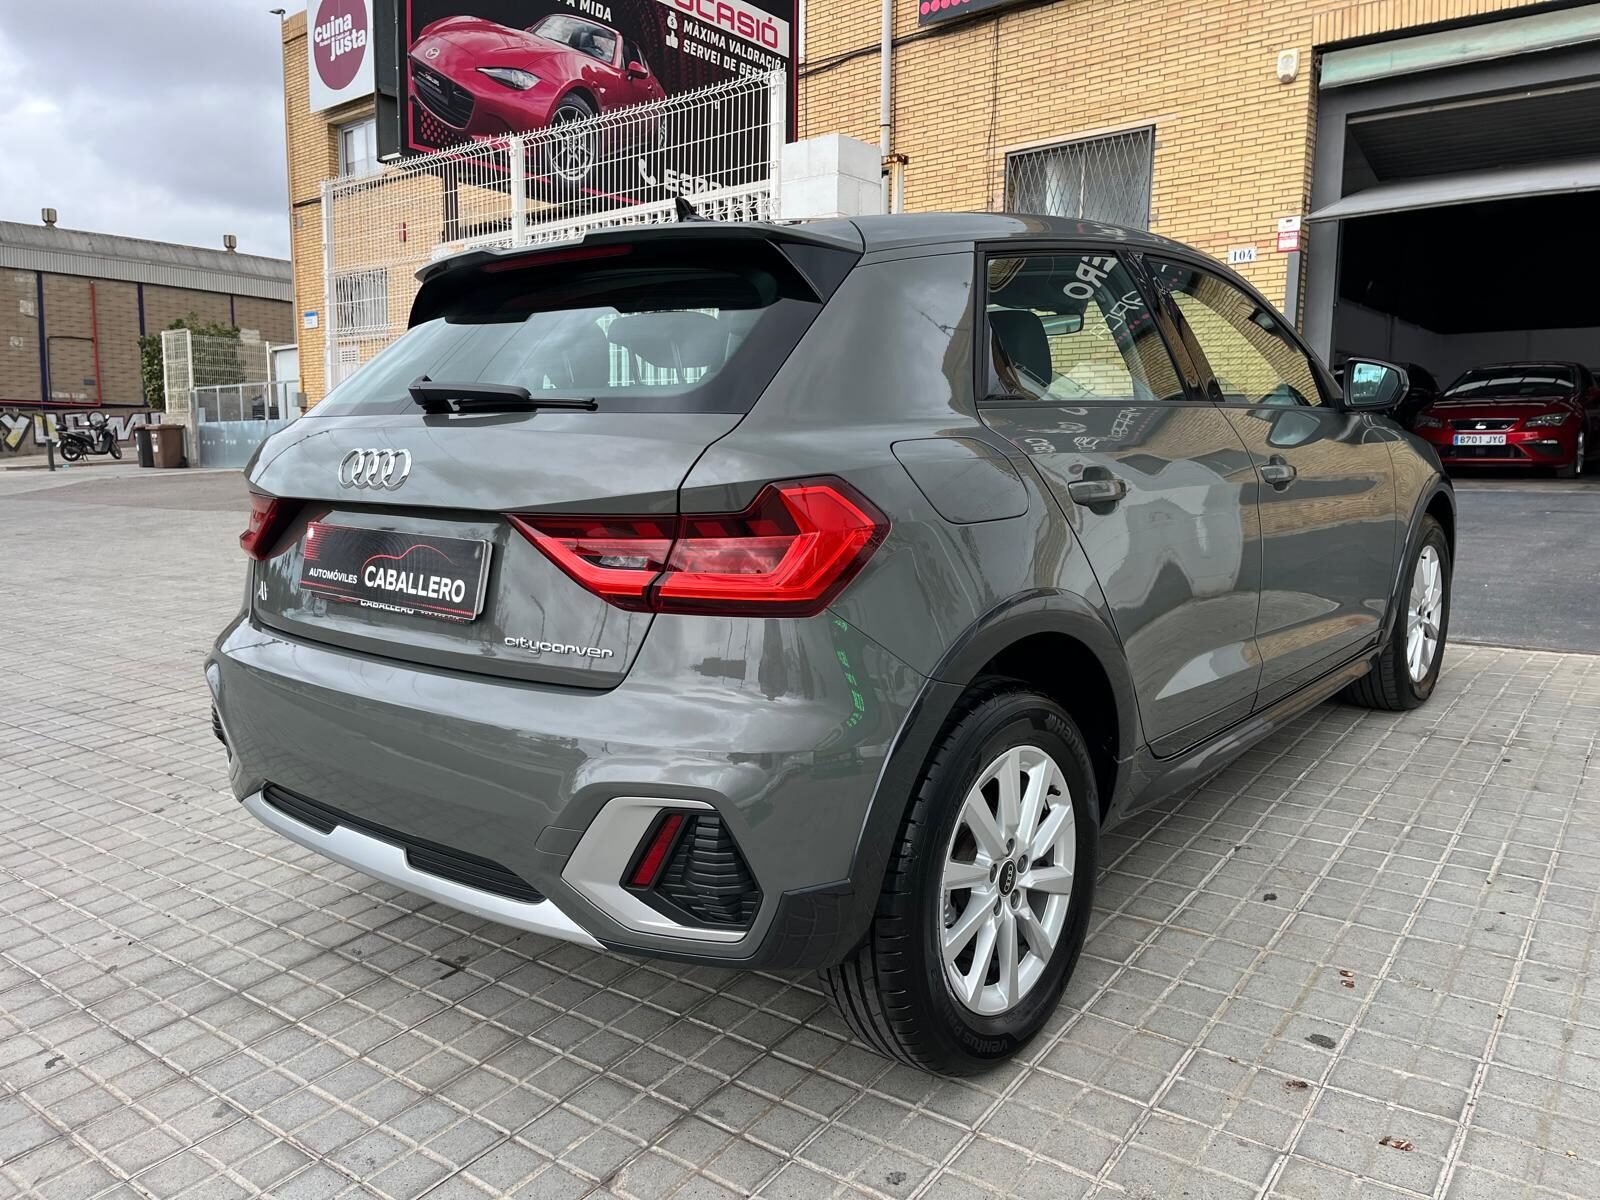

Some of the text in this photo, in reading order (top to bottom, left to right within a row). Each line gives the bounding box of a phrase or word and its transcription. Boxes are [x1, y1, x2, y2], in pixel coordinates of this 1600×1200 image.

[579, 0, 612, 22] MIDA
[314, 13, 352, 43] cuina
[330, 28, 366, 62] justa
[683, 19, 781, 70] MÀXIMA VALORACIÓ
[683, 39, 720, 66] SERVEI
[723, 55, 736, 72] DE
[1233, 249, 1253, 262] 104
[1460, 435, 1504, 444] 8701 JYG
[308, 565, 466, 604] AUTOMÓVILES CABALLERO
[504, 636, 614, 658] citycarver
